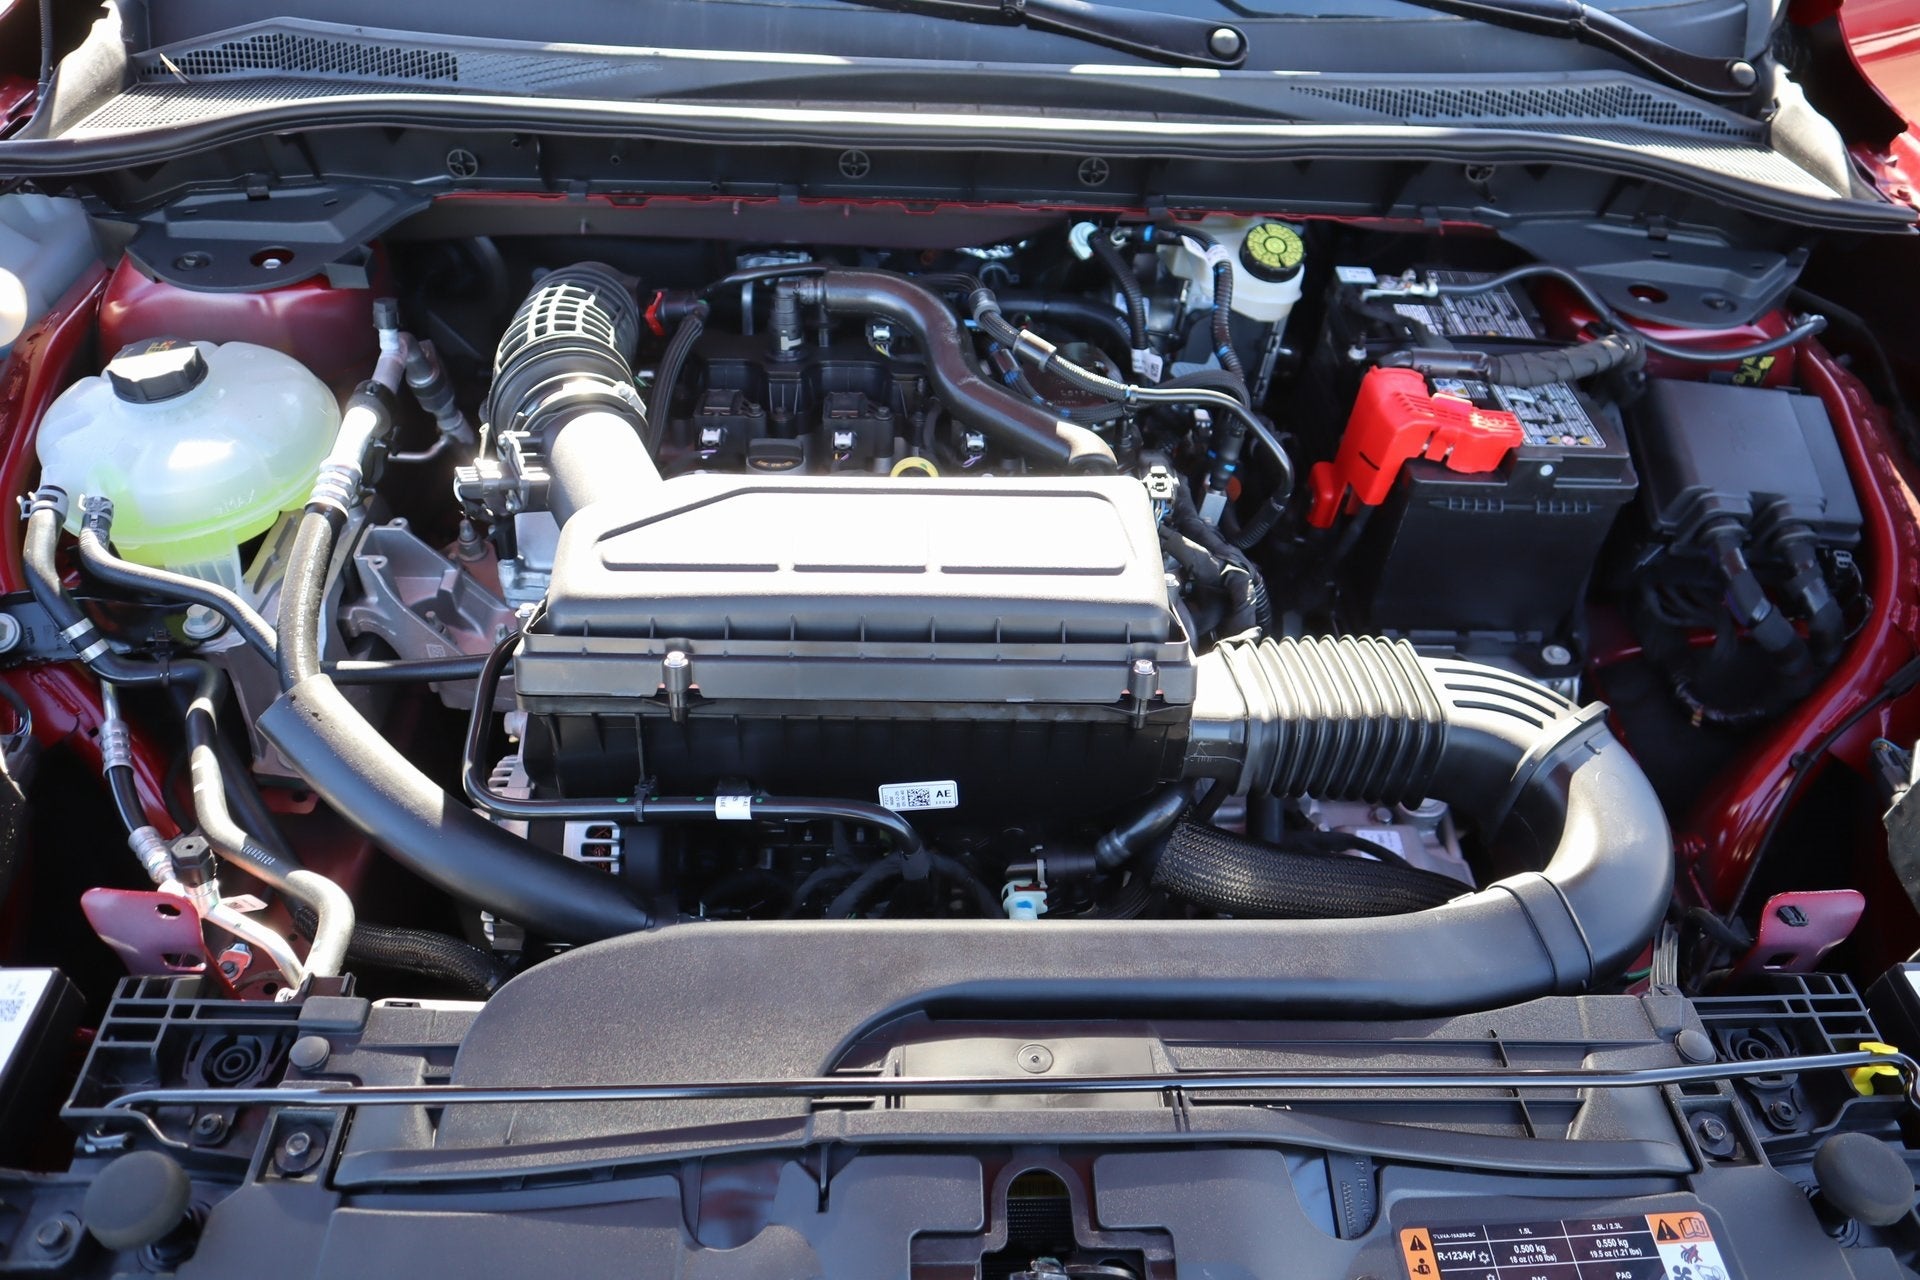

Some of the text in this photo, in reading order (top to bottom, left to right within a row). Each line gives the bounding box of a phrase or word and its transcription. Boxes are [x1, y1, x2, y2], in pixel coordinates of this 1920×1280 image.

[936, 789, 952, 798] AE
[1596, 1238, 1629, 1249] 0.550 kg
[1513, 1244, 1547, 1254] 0.500 kg
[1590, 1250, 1604, 1258] 19.5
[1613, 1249, 1629, 1258] (1.21
[1437, 1250, 1476, 1262] R-1234yf
[1510, 1256, 1518, 1264] 18
[1527, 1255, 1544, 1264] (1.10
[1616, 1271, 1632, 1280] PAG
